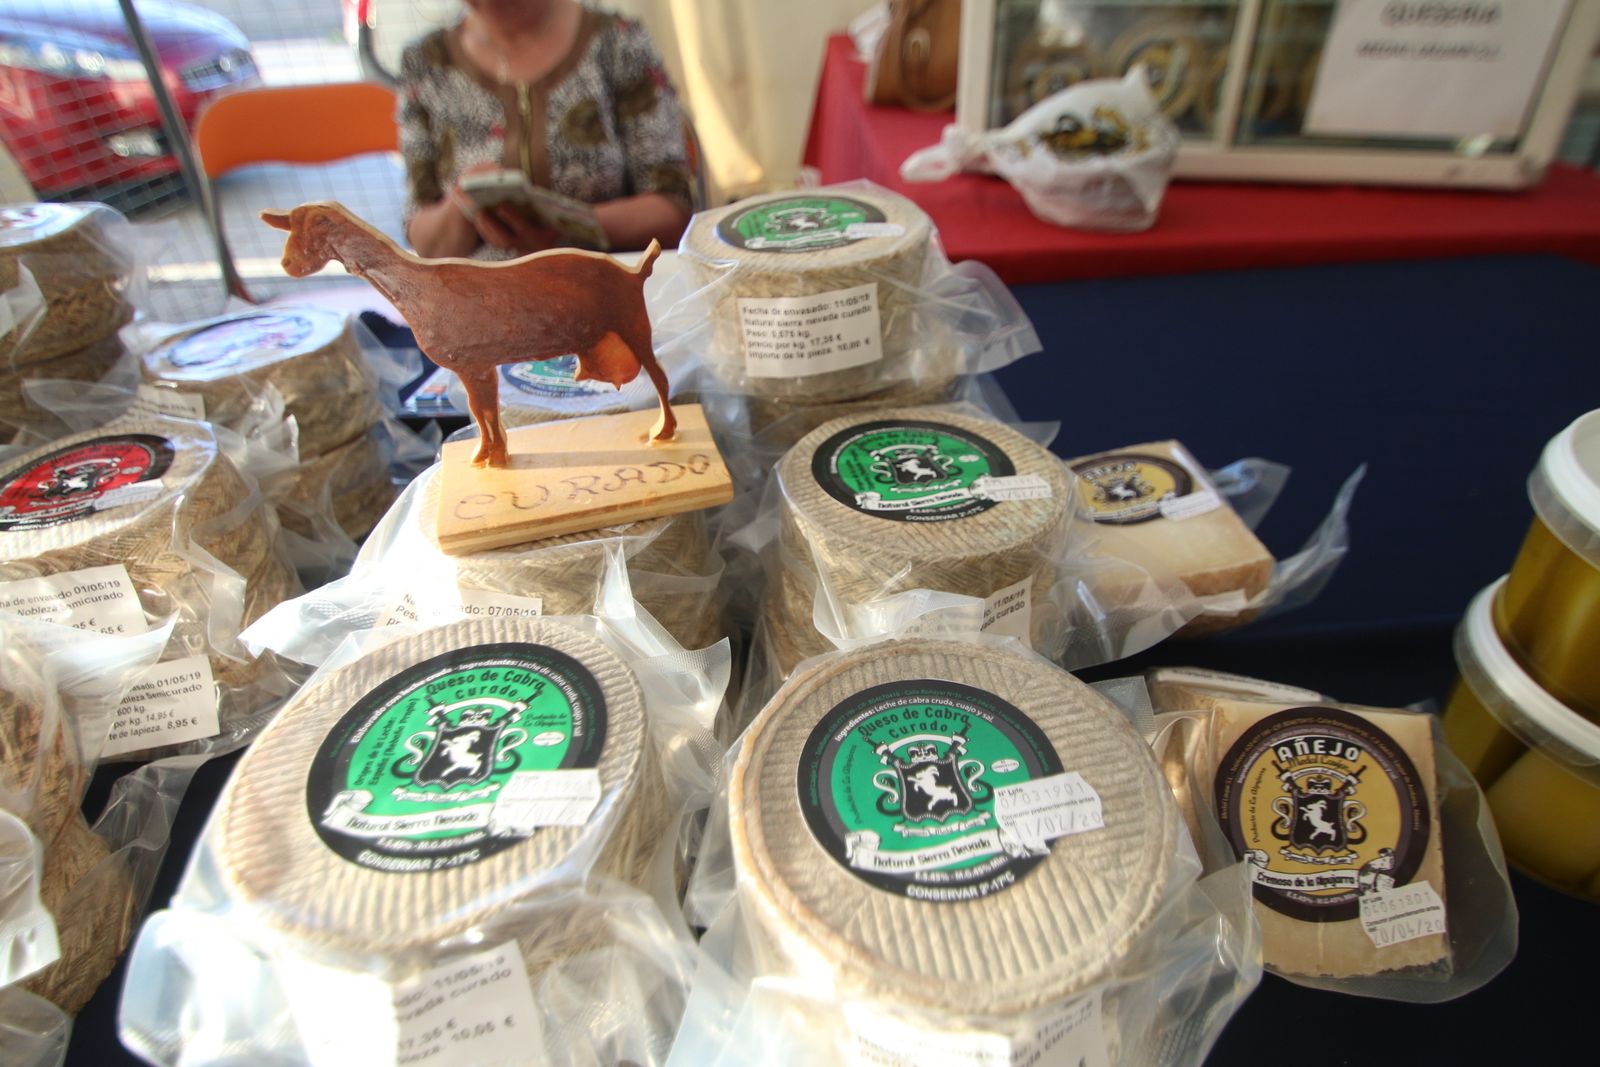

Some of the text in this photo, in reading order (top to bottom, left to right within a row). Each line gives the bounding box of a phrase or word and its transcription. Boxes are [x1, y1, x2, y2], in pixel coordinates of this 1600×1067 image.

[454, 453, 711, 520] CURADO
[13, 598, 25, 607] de
[73, 579, 121, 595] 01/05/19
[996, 600, 1026, 620] curado
[156, 671, 201, 689] 01/05/19
[425, 670, 547, 696] Queso de Cabra
[145, 684, 203, 701] Semicurado
[350, 706, 387, 743] Elaborado
[458, 658, 518, 671] Ingredientes:
[518, 660, 541, 671] Leche
[454, 684, 518, 700] Curado
[113, 720, 127, 731] por
[168, 708, 175, 718] €
[167, 718, 188, 730] 8,95
[191, 716, 199, 726] €
[834, 709, 876, 742] Ingredientes:
[874, 701, 897, 714] Leche
[897, 698, 908, 706] de
[931, 698, 955, 707] cruda,
[955, 703, 977, 715] cuajo
[857, 706, 970, 737] Queso de Cabra
[888, 720, 949, 739] Curado
[1276, 736, 1360, 763] AÑEJO
[345, 811, 479, 831] Natural Sierra Nevada
[357, 850, 432, 871] CONSERVAR
[873, 838, 992, 868] Natural Sierra Nevada
[1257, 871, 1293, 887] Cremoso
[1294, 877, 1305, 887] de
[906, 883, 978, 901] CONSERVAR
[450, 968, 513, 999] curado
[503, 1014, 515, 1029] €
